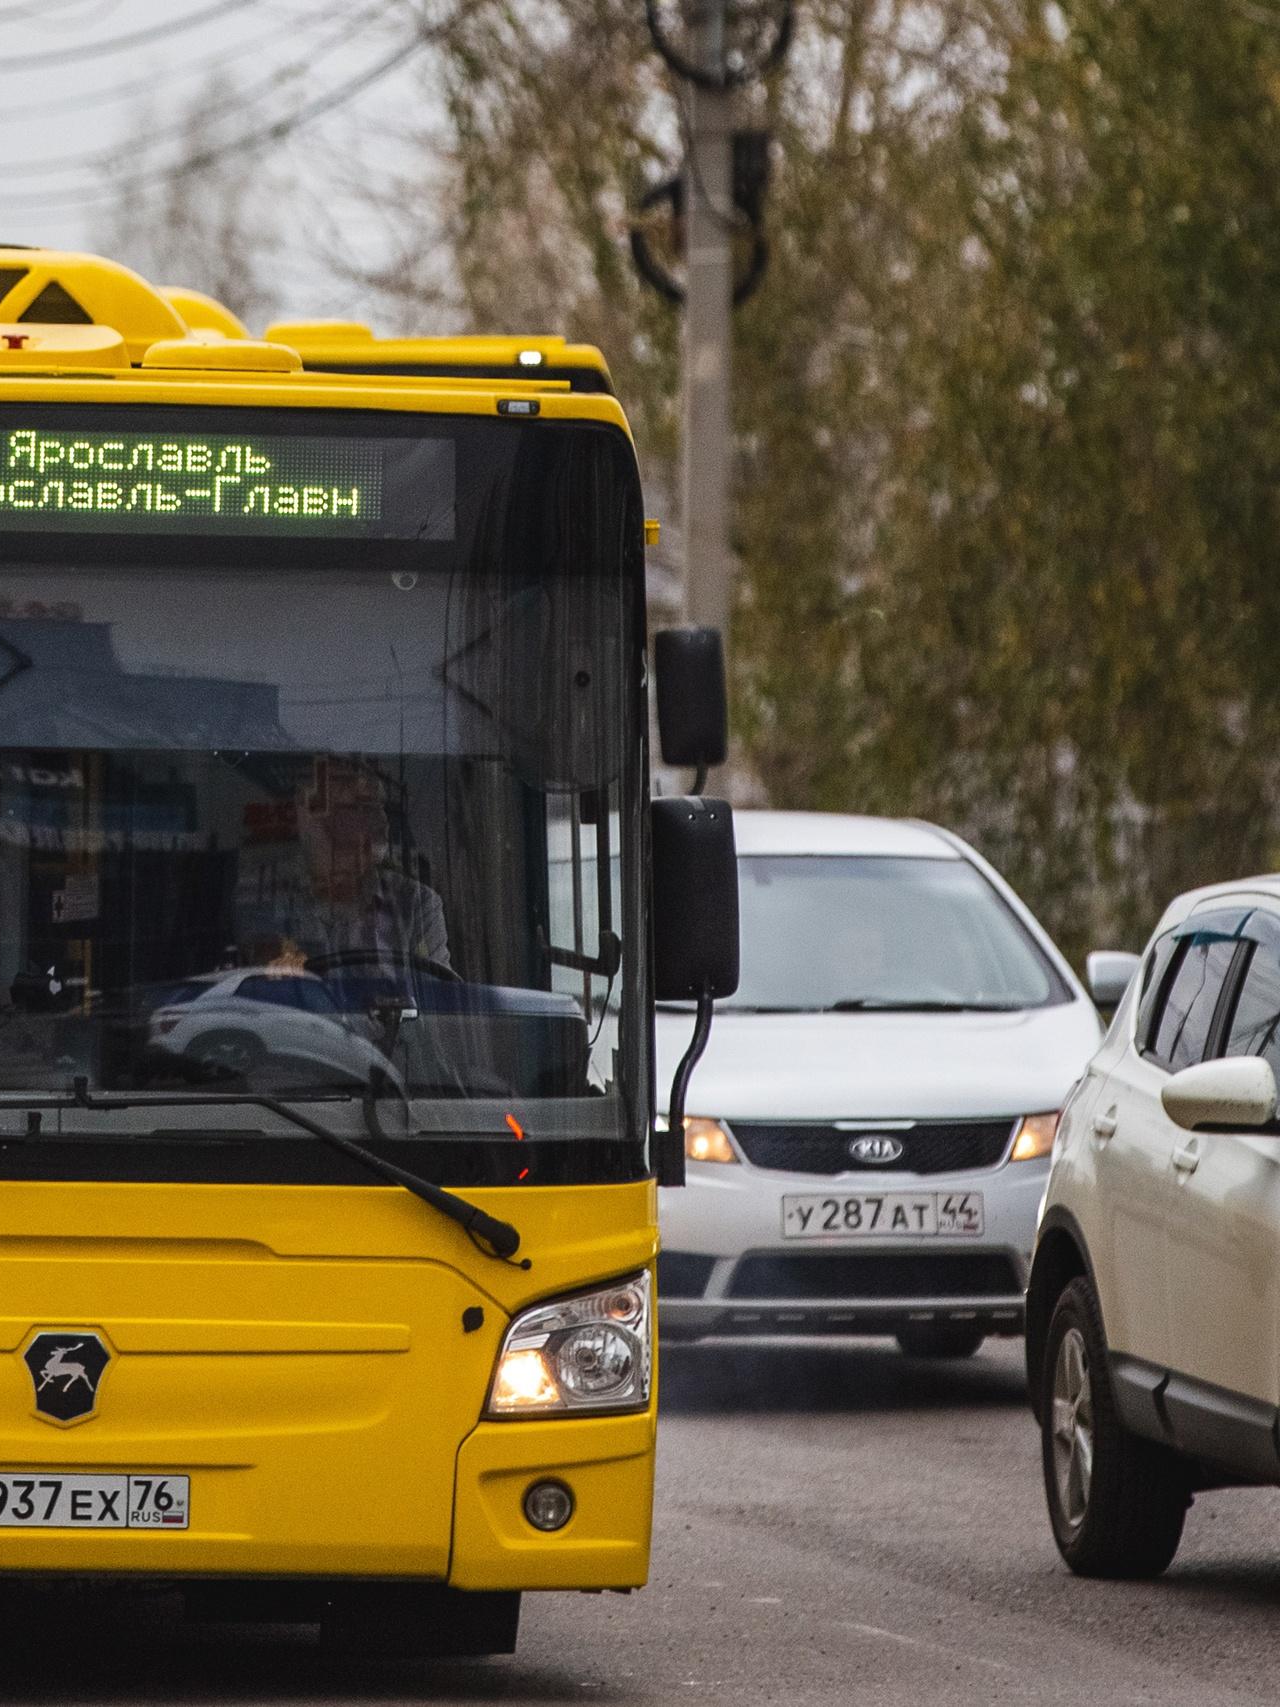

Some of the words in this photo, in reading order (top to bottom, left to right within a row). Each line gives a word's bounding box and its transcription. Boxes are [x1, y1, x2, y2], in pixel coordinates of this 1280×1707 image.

[9, 429, 271, 474] Ярославль
[942, 1194, 973, 1221] 44
[133, 1480, 174, 1512] 76
[131, 1511, 161, 1523] RUS
